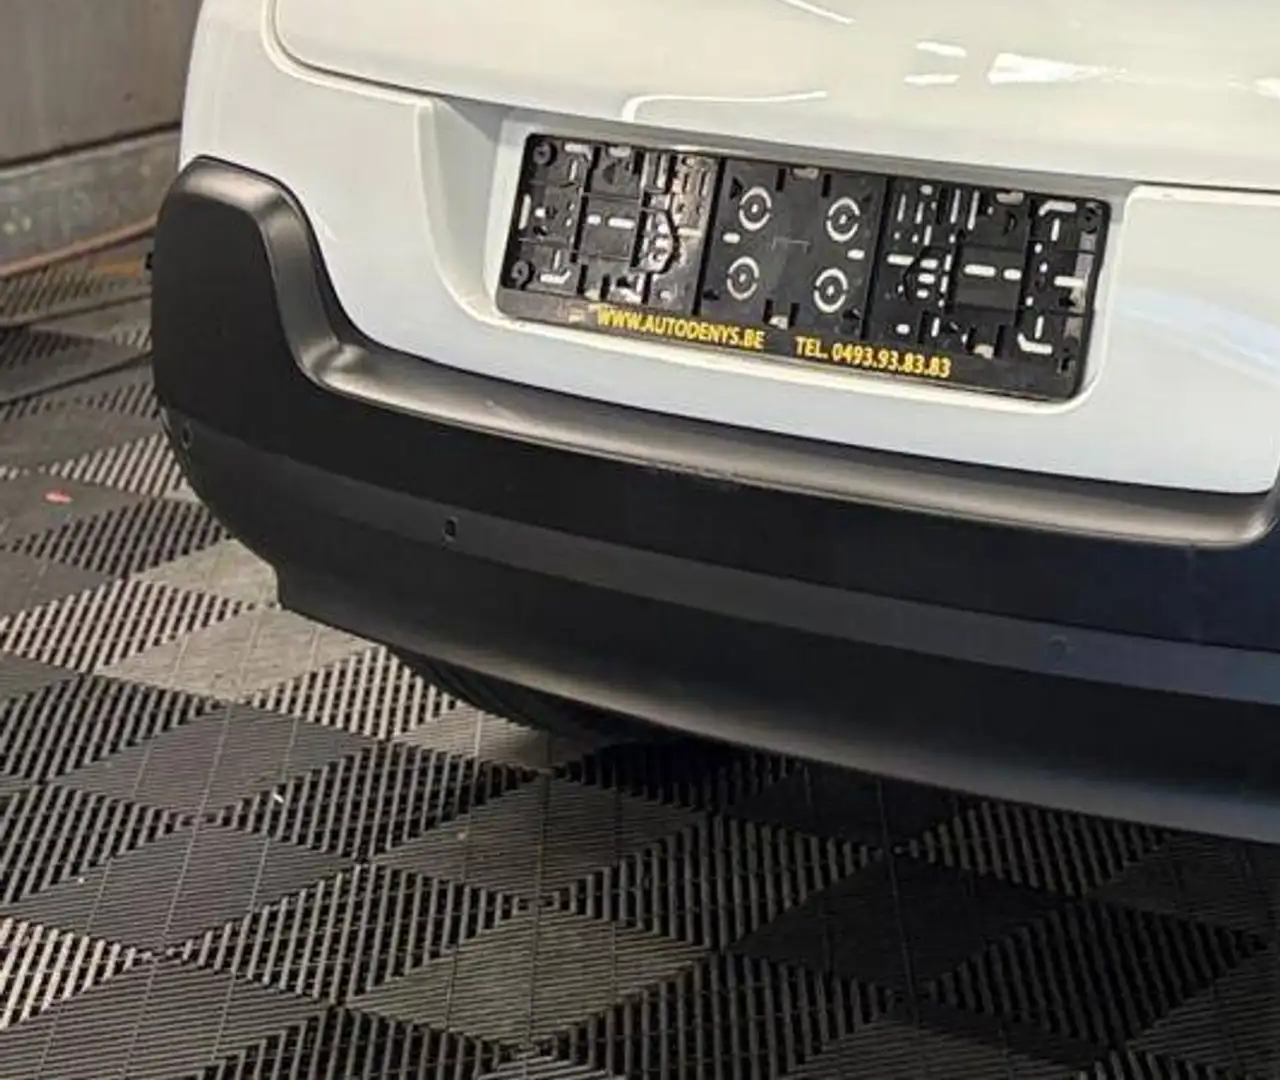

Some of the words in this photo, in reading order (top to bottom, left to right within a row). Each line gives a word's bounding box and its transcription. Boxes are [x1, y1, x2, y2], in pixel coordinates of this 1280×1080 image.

[596, 305, 766, 350] WWW.AUTODENYS.BE
[794, 335, 829, 359] TEL.
[831, 342, 952, 379] 0493.93.83.83
